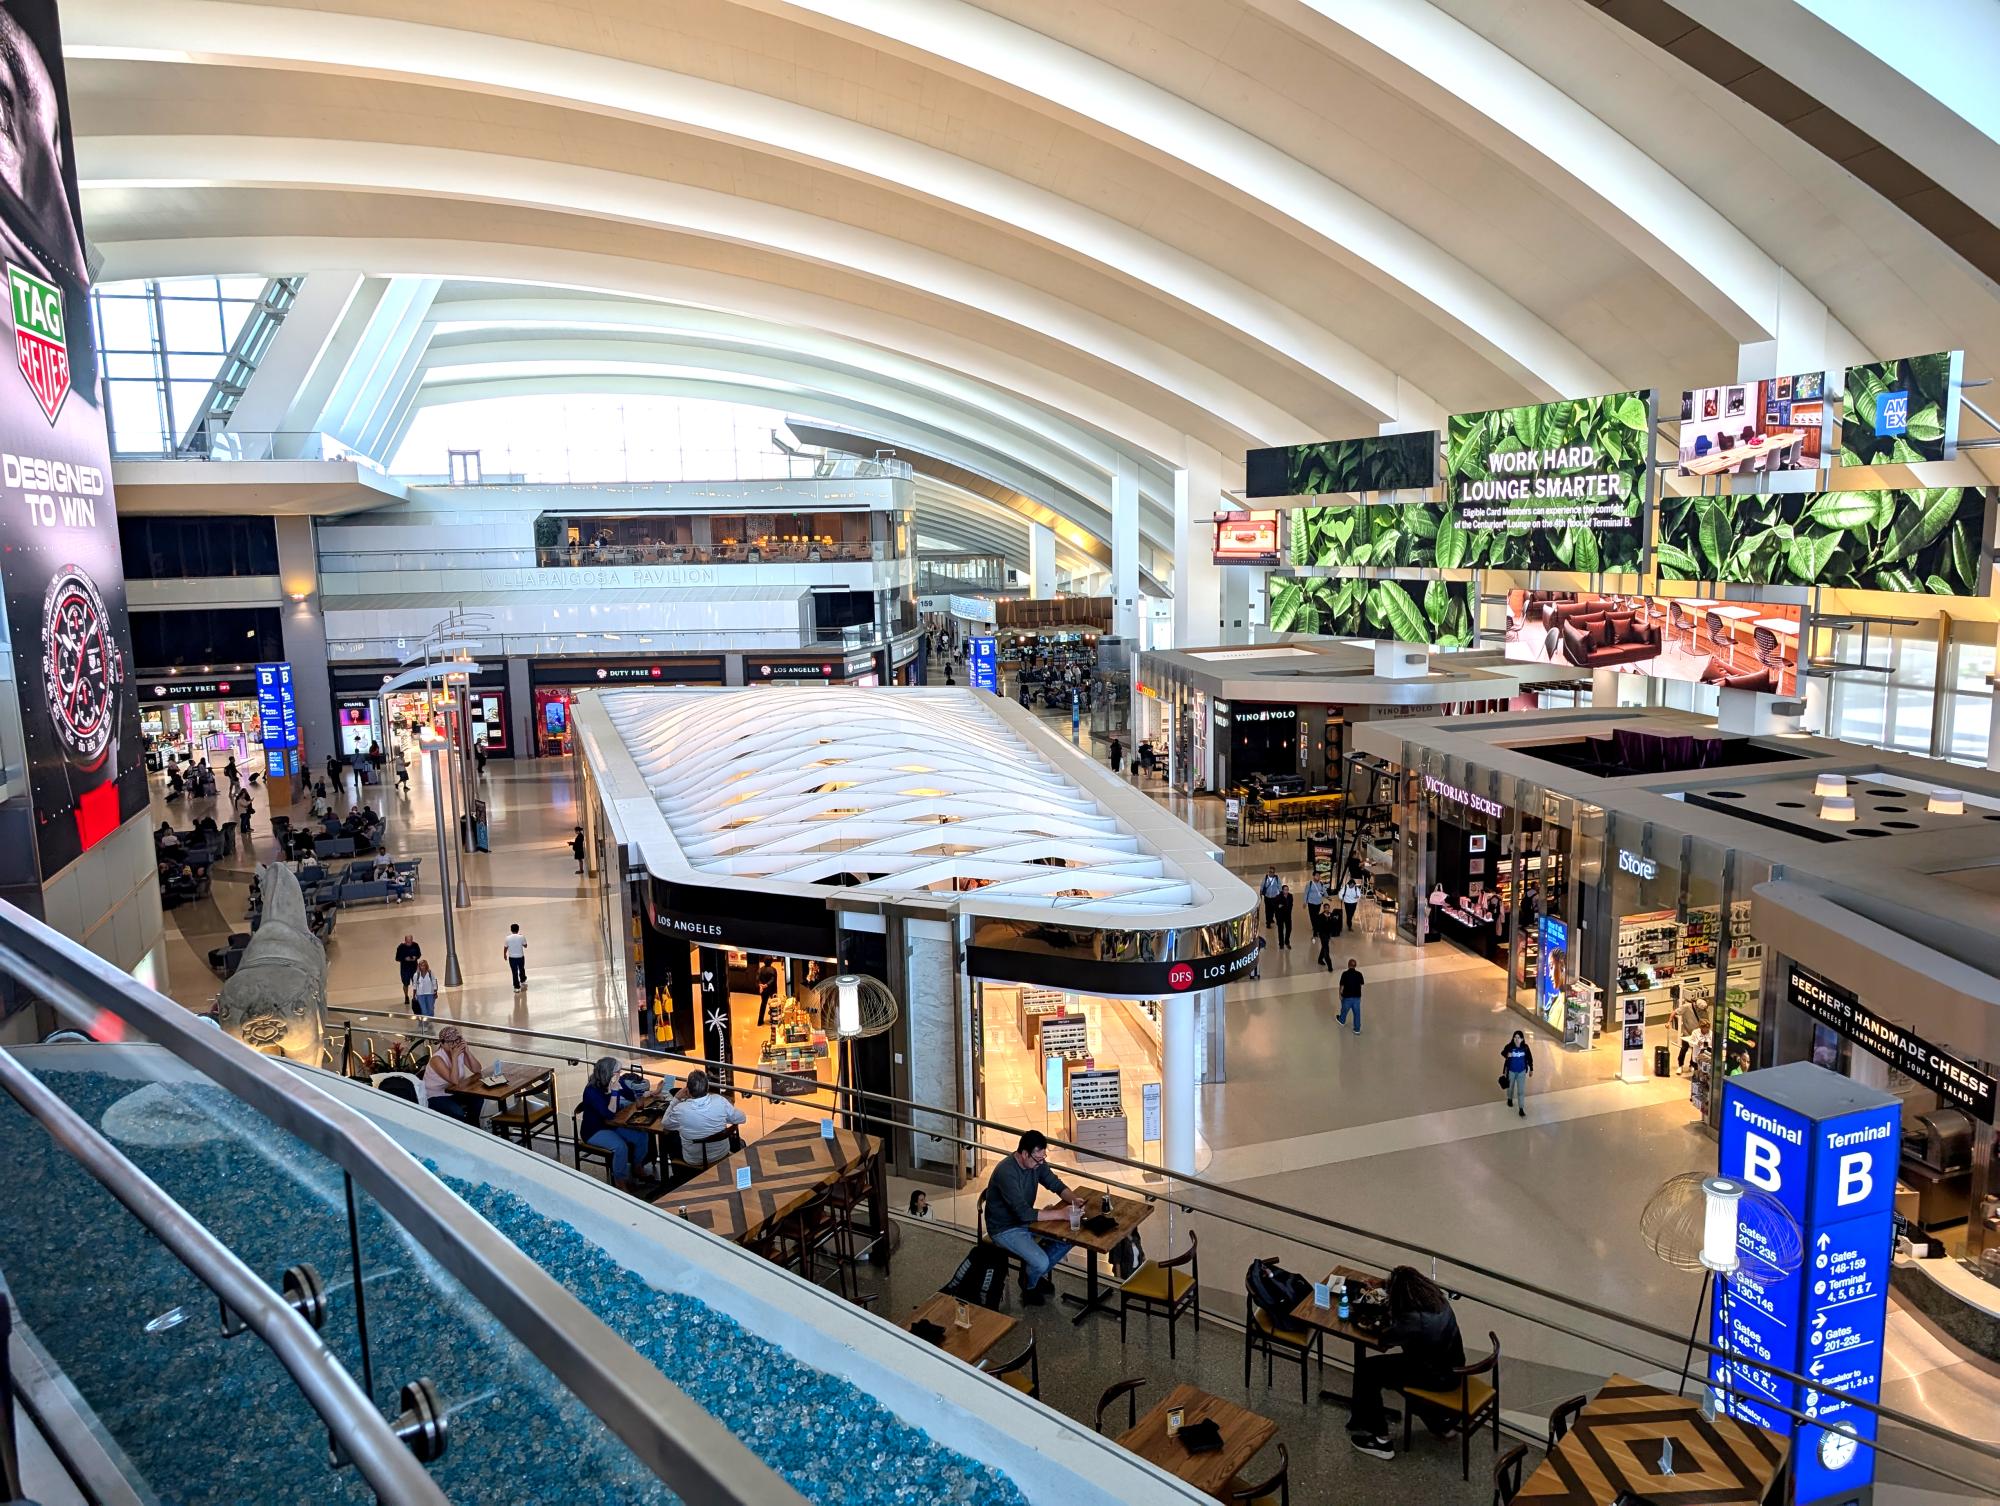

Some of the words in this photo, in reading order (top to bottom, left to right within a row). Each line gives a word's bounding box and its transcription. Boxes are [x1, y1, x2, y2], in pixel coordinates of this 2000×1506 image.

[12, 275, 60, 337] TAG
[19, 335, 68, 409] HEUER
[1884, 398, 1907, 416] AM
[1886, 413, 1907, 428] EX
[1489, 451, 1539, 473] WORK
[1544, 447, 1598, 469] HARD,
[2, 454, 104, 496] DESIGNED
[1464, 480, 1530, 500] LOUNGE
[1534, 474, 1626, 498] SMARTER.
[24, 494, 56, 528] TO
[59, 496, 96, 528] WIN
[1463, 508, 1485, 518] Eligible
[1486, 507, 1501, 516] Card
[1502, 506, 1532, 516] Members
[1533, 508, 1544, 516] can
[1546, 508, 1581, 516] experience
[1583, 505, 1594, 514] the
[1596, 504, 1624, 514] comfort
[1454, 520, 1460, 528] of
[1462, 520, 1472, 528] the
[1508, 520, 1530, 530] Lounge
[1542, 520, 1552, 528] the
[1585, 518, 1592, 527] of
[1593, 518, 1622, 527] Terminal
[1624, 517, 1632, 527] B.
[485, 570, 620, 586] VILLARAIGOSA
[632, 568, 713, 586] PAVILION
[981, 644, 990, 656] B
[262, 672, 272, 684] B
[282, 671, 288, 684] B
[1236, 714, 1258, 722] VINO
[1270, 710, 1295, 718] VOLO
[1377, 707, 1399, 715] VINO
[1426, 776, 1468, 804] VICTORIA'S
[1470, 794, 1502, 818] SECRET
[1619, 850, 1652, 880] iStore
[658, 914, 670, 927] LOS
[674, 920, 722, 935] ANGELES
[1172, 972, 1192, 982] DFS
[1204, 964, 1225, 978] LOS
[1230, 947, 1258, 972] ANGELES
[702, 982, 714, 992] LA
[1792, 974, 1850, 1017] BEECHER'S
[1854, 1011, 1926, 1062] HANDMADE
[1930, 1056, 1988, 1098] CHEESE
[1798, 995, 1810, 1006] MAC
[1819, 1008, 1841, 1026] CHEESE
[1852, 1028, 1894, 1058] SANDWICHES
[1907, 1061, 1930, 1080] SOUPS
[1944, 1082, 1973, 1105] SALADS
[1732, 1100, 1802, 1146] Terminal
[1826, 1122, 1890, 1149] Terminal
[1744, 1131, 1782, 1192] B
[1838, 1152, 1872, 1206] B
[1739, 1222, 1767, 1244] Gates
[1738, 1234, 1776, 1262] 201-235
[1831, 1250, 1857, 1264] Gates
[1830, 1258, 1866, 1275] 148-159
[1737, 1272, 1764, 1294] Gates
[1828, 1272, 1866, 1290] Terminal
[1736, 1283, 1774, 1312] 130-146
[1828, 1292, 1836, 1302] 4,
[1838, 1289, 1846, 1300] 5,
[1848, 1287, 1854, 1296] 6
[1856, 1285, 1864, 1294] &
[1866, 1282, 1872, 1292] 7
[1734, 1319, 1762, 1342] Gates
[1826, 1326, 1852, 1340] Gates
[1733, 1331, 1770, 1360] 148-159
[1824, 1334, 1860, 1352] 201-235
[1742, 1364, 1750, 1378] 5,
[1752, 1372, 1758, 1382] 6
[1761, 1378, 1768, 1389] &
[1771, 1382, 1777, 1392] 7
[1822, 1372, 1853, 1386] Escalator
[1857, 1378, 1862, 1386] 2
[1862, 1376, 1868, 1384] &
[1820, 1404, 1840, 1414] Gates
[1762, 1418, 1770, 1428] to
